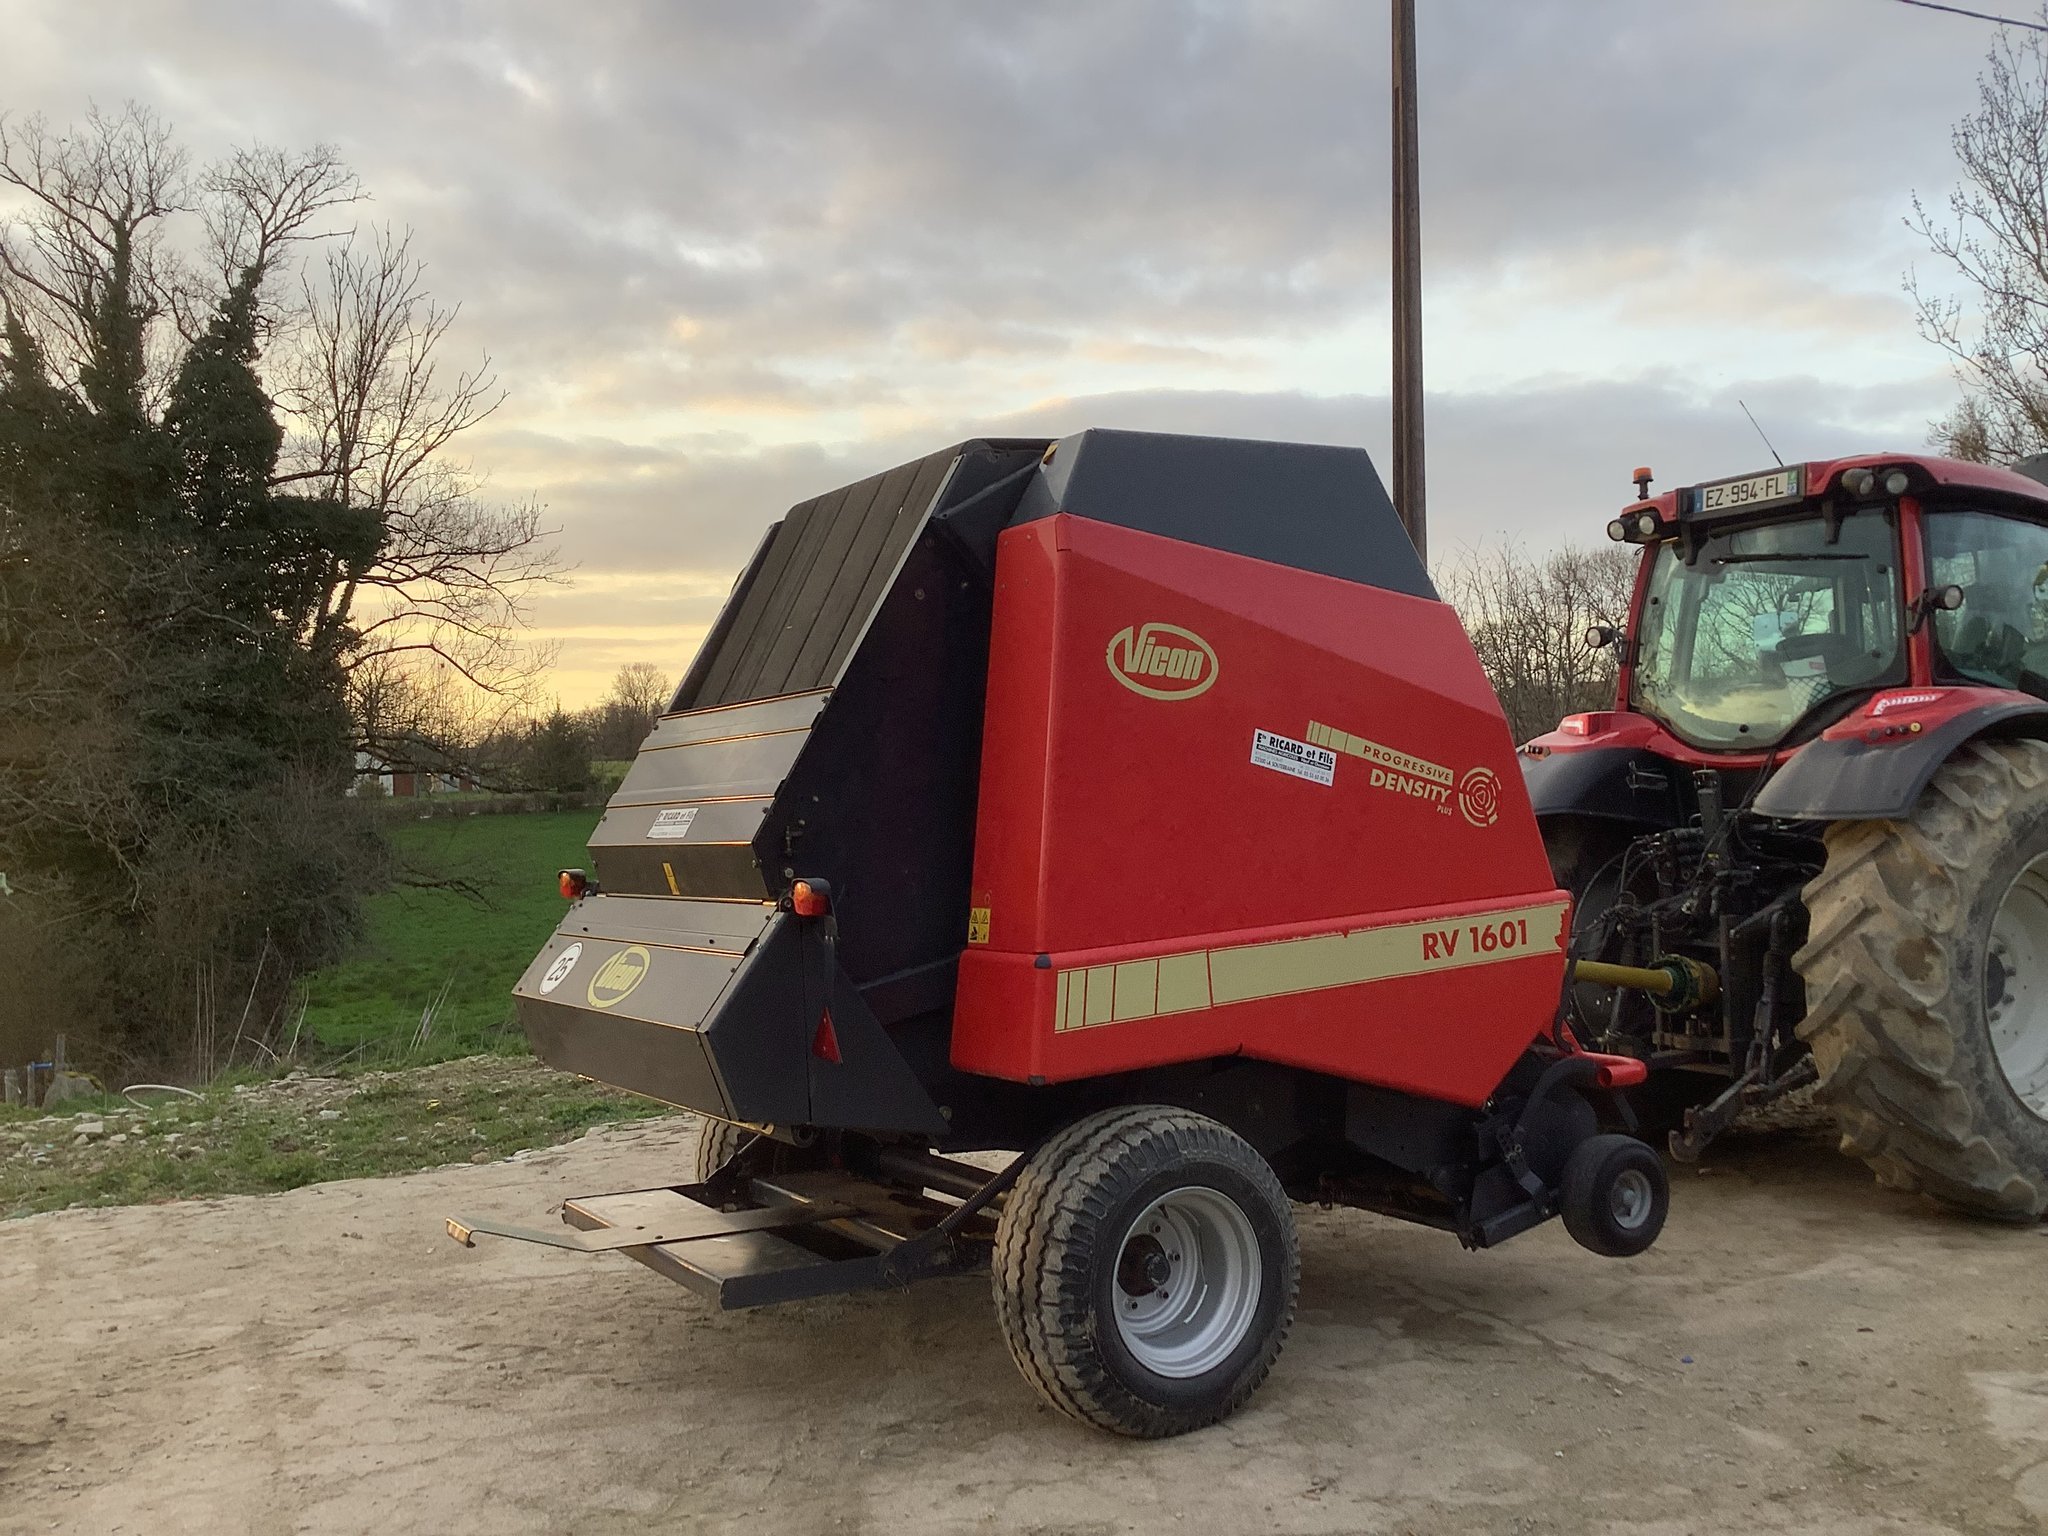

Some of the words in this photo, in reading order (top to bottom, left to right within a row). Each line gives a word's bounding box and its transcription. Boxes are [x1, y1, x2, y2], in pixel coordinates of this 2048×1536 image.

[1705, 477, 1784, 508] EZ-994-FL
[1122, 622, 1206, 682] Vicon
[1269, 736, 1304, 756] RICARD
[1306, 749, 1316, 760] et
[1318, 751, 1334, 765] Fils
[1363, 745, 1451, 782] PROGRESSIVE
[1369, 768, 1452, 803] DENSITY
[1436, 804, 1453, 816] PLUS
[1422, 928, 1460, 960] RV
[1469, 919, 1527, 953] 1601
[547, 957, 574, 981] 25
